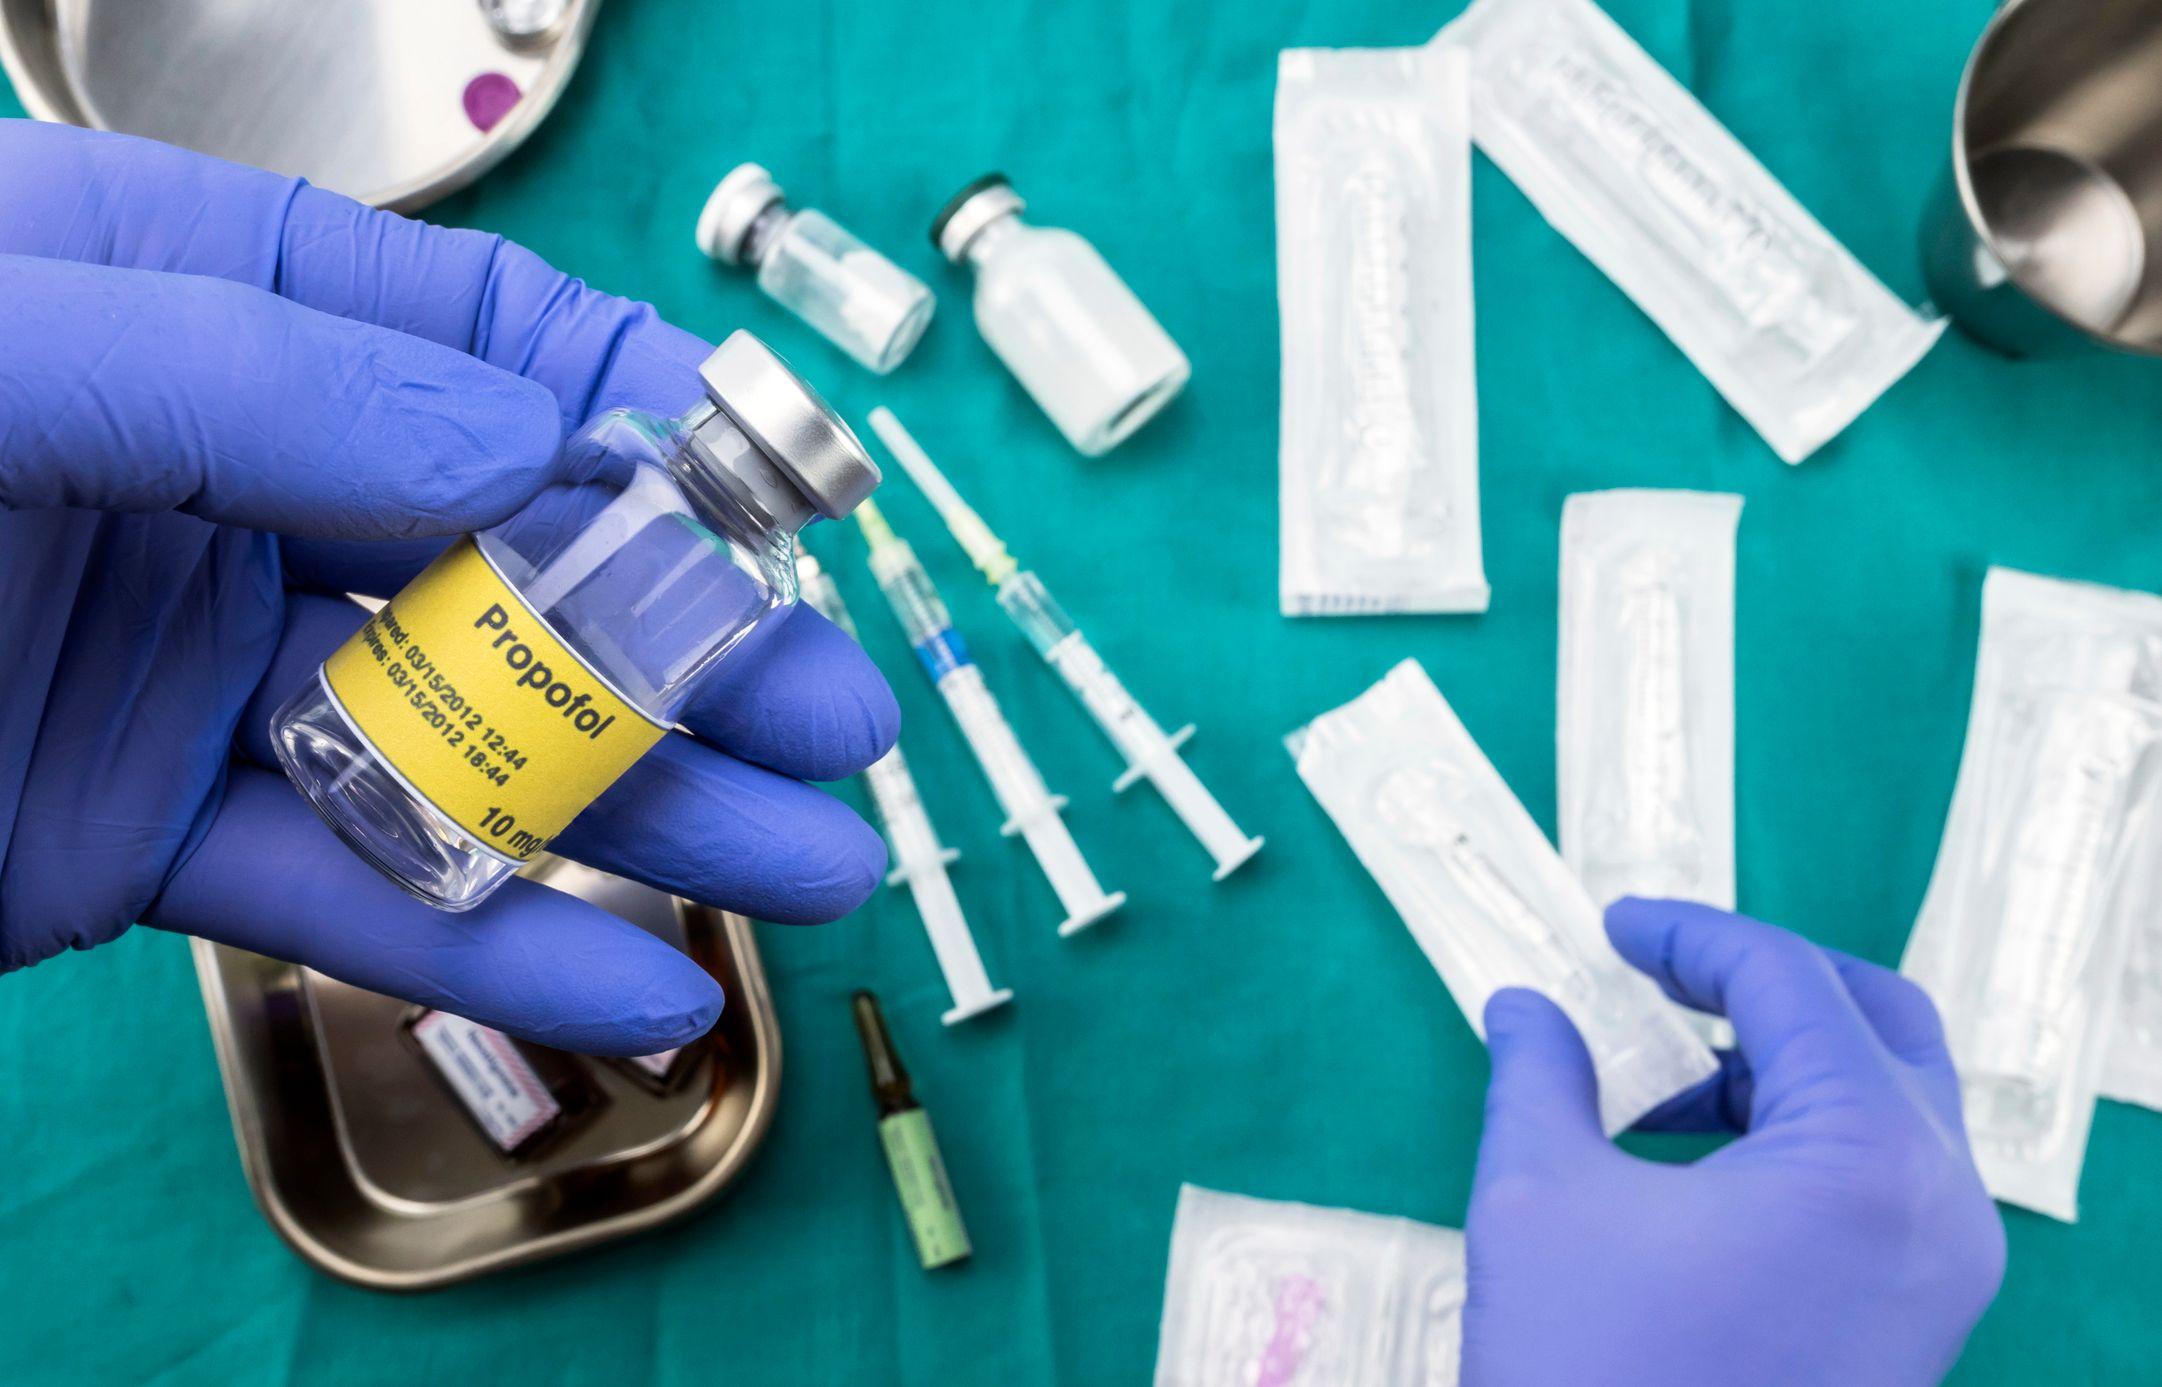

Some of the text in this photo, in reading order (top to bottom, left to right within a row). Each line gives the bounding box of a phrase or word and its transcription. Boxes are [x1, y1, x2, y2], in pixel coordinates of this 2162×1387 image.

[387, 662, 465, 748] 03/15/2012
[463, 744, 511, 787] 18:44
[405, 645, 483, 731] 03/15/2012
[481, 727, 528, 771] 12:44
[474, 602, 616, 740] Propofol
[479, 807, 516, 838] 10
